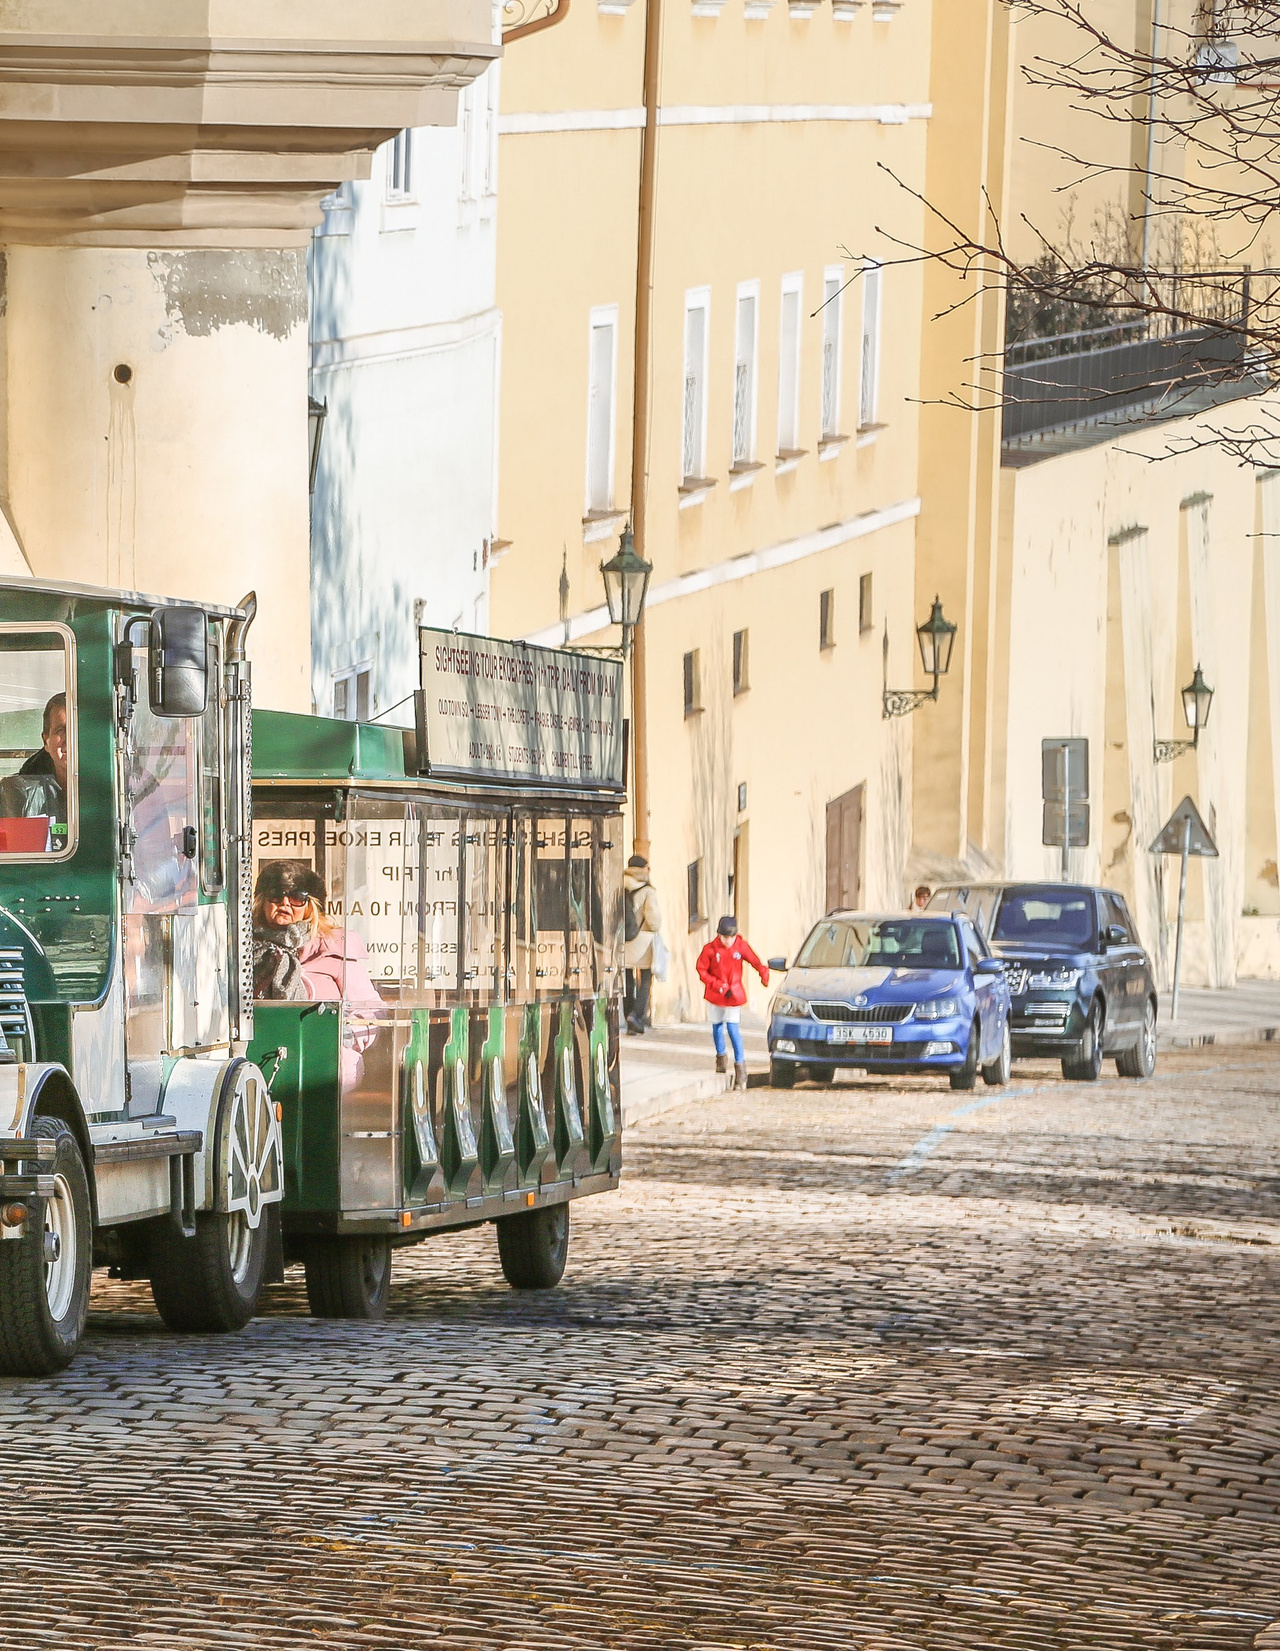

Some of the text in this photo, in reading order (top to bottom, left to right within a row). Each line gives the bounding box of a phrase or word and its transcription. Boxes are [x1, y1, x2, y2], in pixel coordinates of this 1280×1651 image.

[435, 645, 480, 677] SIGHTSEEING
[481, 652, 499, 680] TOUR
[438, 698, 448, 715] OLD
